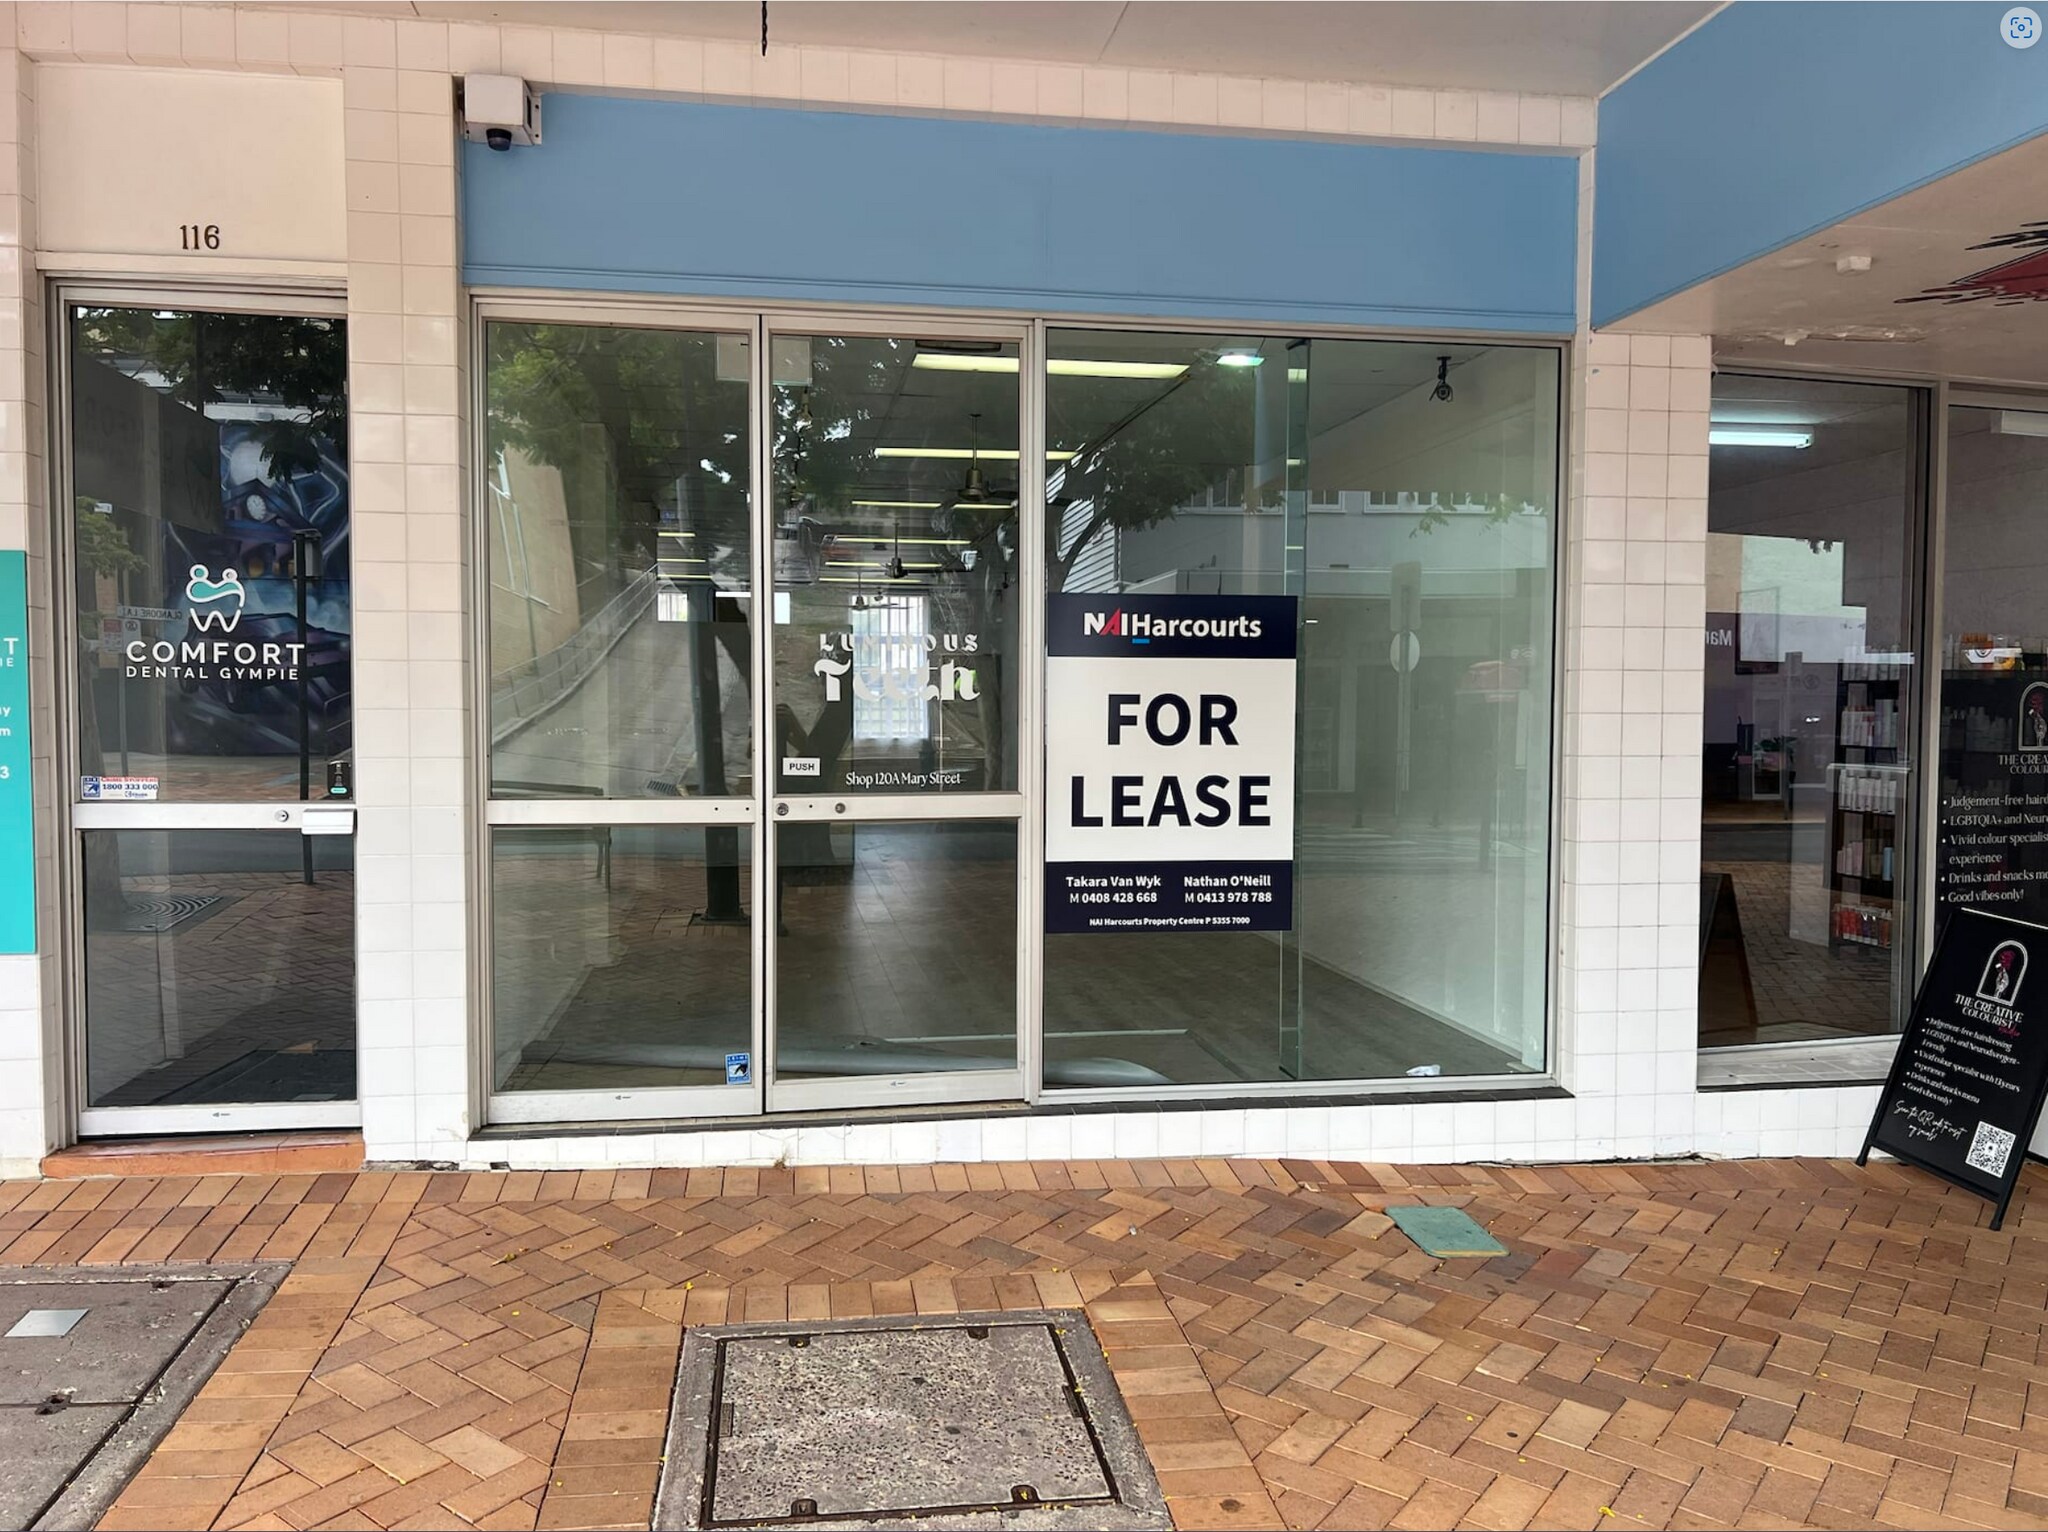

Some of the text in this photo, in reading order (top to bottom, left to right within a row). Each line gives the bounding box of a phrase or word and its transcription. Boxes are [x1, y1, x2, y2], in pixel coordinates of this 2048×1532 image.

[180, 225, 220, 250] 116
[1131, 613, 1262, 638] Harcourts
[126, 640, 305, 665] COMFORT
[126, 666, 298, 681] DENTAL GYMPIE
[1107, 693, 1239, 746] FOR
[789, 763, 815, 771] PUSH
[845, 771, 961, 789] Shop 120A Mary Street
[1071, 774, 1271, 828] LEASE
[1949, 795, 2023, 811] Judgement-free
[2004, 813, 2022, 825] and
[1950, 833, 1976, 845] Vivid
[1977, 833, 2008, 844] colour
[1949, 853, 2003, 868] experience
[1065, 874, 1161, 889] Takara Van Wyk
[1184, 874, 1272, 887] Nathan O'Neill
[1948, 871, 1981, 884] Drinks
[1983, 870, 2002, 882] and
[2003, 869, 2035, 881] snacks
[1069, 892, 1158, 903] M 0408 428 668
[1184, 892, 1272, 903] M 0413 978 788
[1947, 890, 1974, 903] Good
[1976, 889, 2000, 901] vibes
[1104, 917, 1143, 926] Harcourts
[1143, 917, 1178, 927] Property
[1178, 916, 1204, 925] Centre
[1231, 916, 1251, 924] 7000
[1955, 994, 2024, 1023] THE CREATIVE
[1962, 1006, 2015, 1029] COLOURIST
